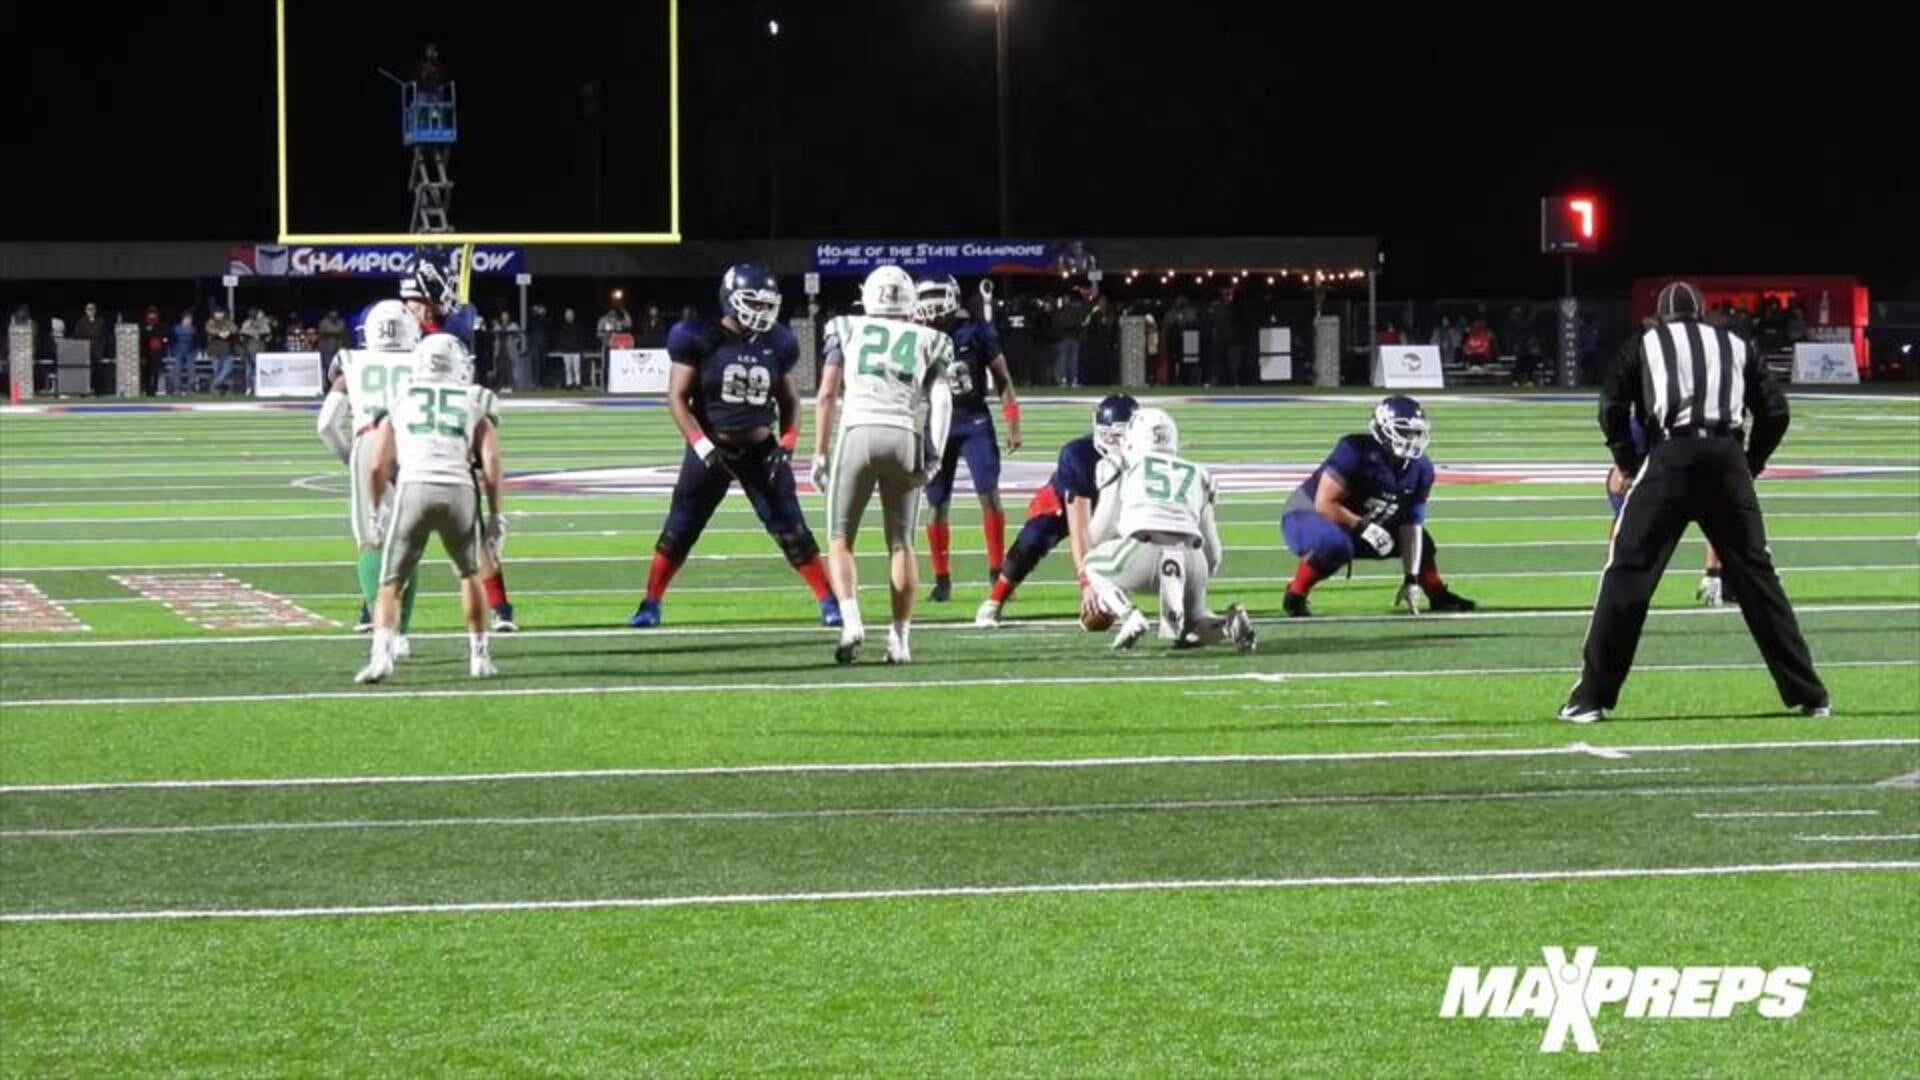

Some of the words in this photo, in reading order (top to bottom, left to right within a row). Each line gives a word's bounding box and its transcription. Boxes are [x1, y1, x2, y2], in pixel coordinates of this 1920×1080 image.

[1569, 200, 1594, 239] 7
[291, 247, 432, 274] CHAMPIO
[858, 323, 917, 382] 24
[406, 386, 468, 437] 35
[1143, 455, 1197, 503] 57
